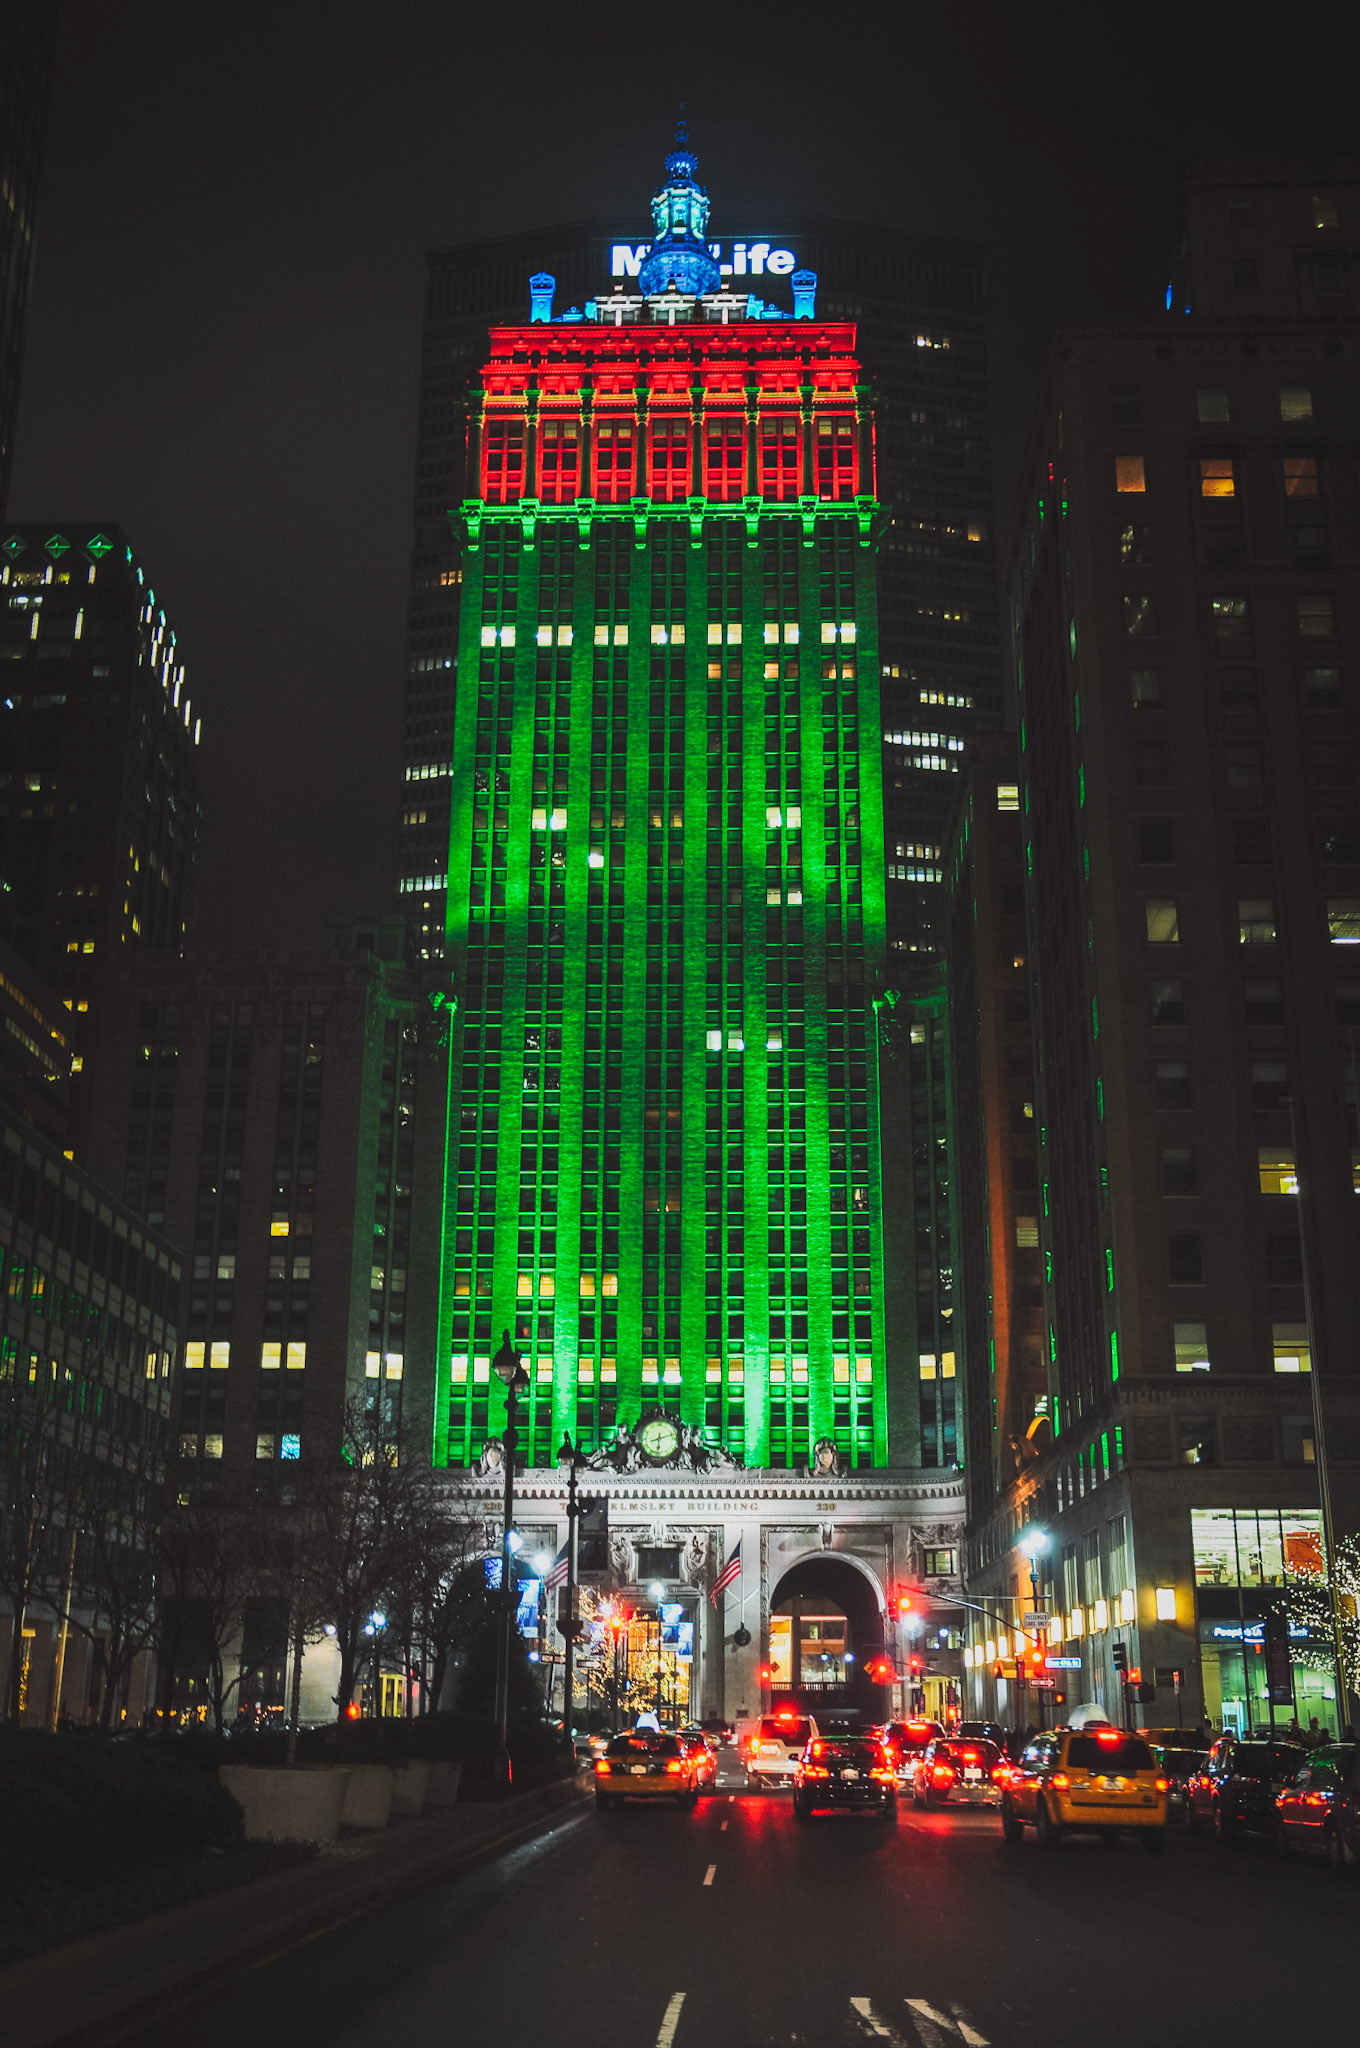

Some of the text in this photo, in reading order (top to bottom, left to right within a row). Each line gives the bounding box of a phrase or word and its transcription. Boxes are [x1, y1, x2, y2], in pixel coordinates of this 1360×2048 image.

[612, 243, 795, 277] MLife
[609, 1502, 759, 1511] ELMSLEY BUILDING
[815, 1502, 837, 1512] 230
